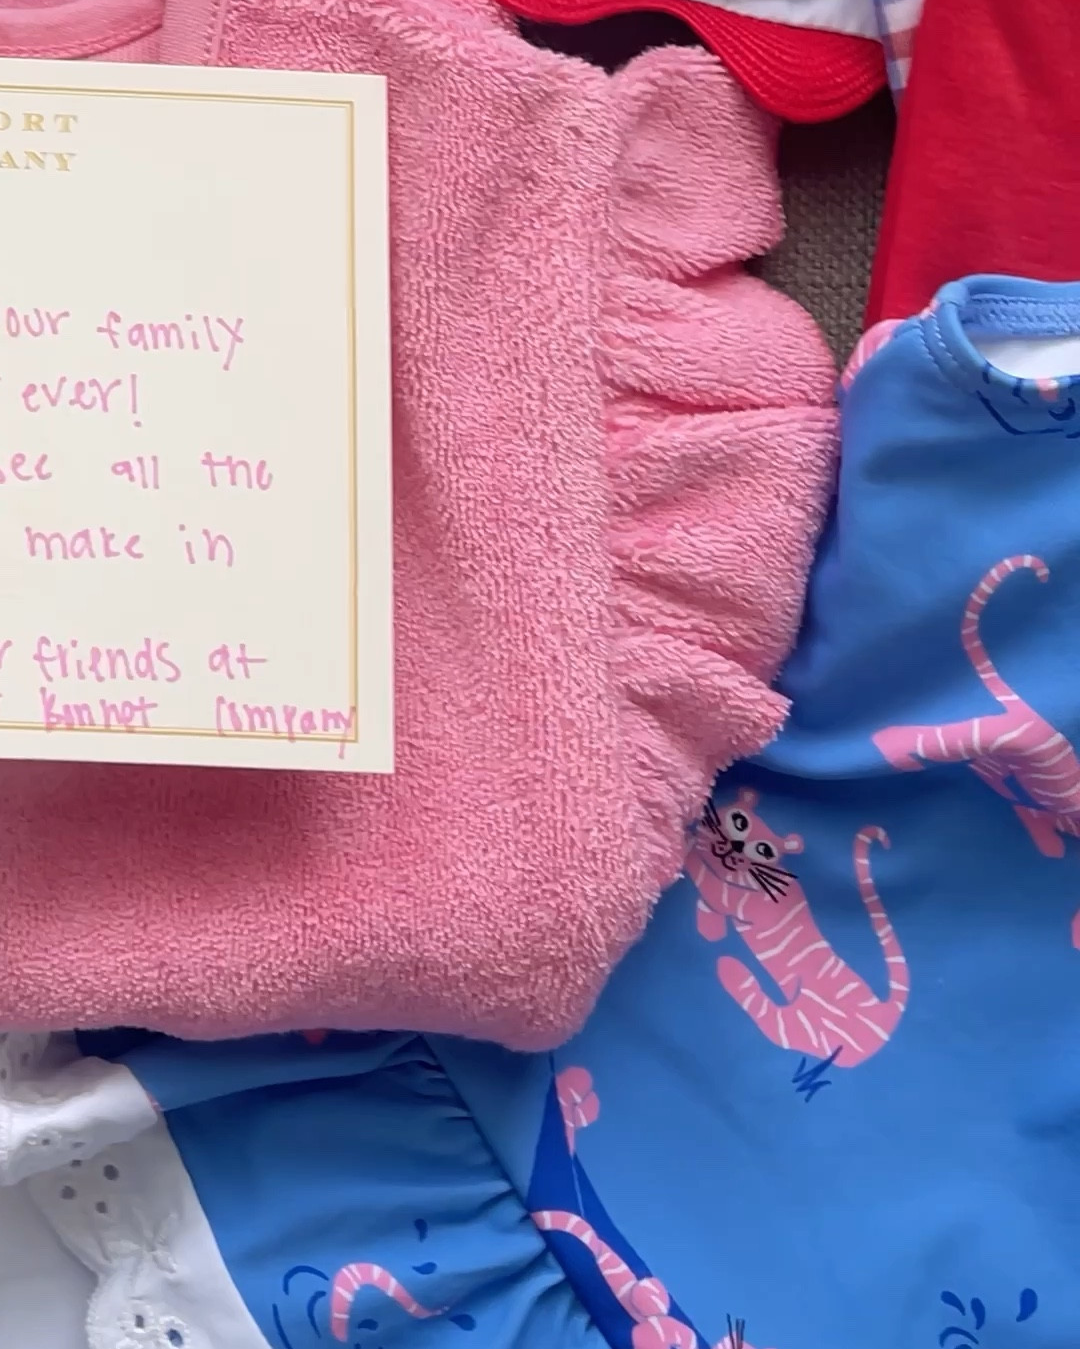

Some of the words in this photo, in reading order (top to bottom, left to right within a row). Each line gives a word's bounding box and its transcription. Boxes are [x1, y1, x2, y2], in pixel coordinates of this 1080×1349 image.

[96, 309, 245, 371] family
[110, 454, 160, 489] all
[24, 526, 143, 561] make
[178, 524, 235, 567] in
[32, 635, 181, 683] friends
[207, 642, 269, 680] at
